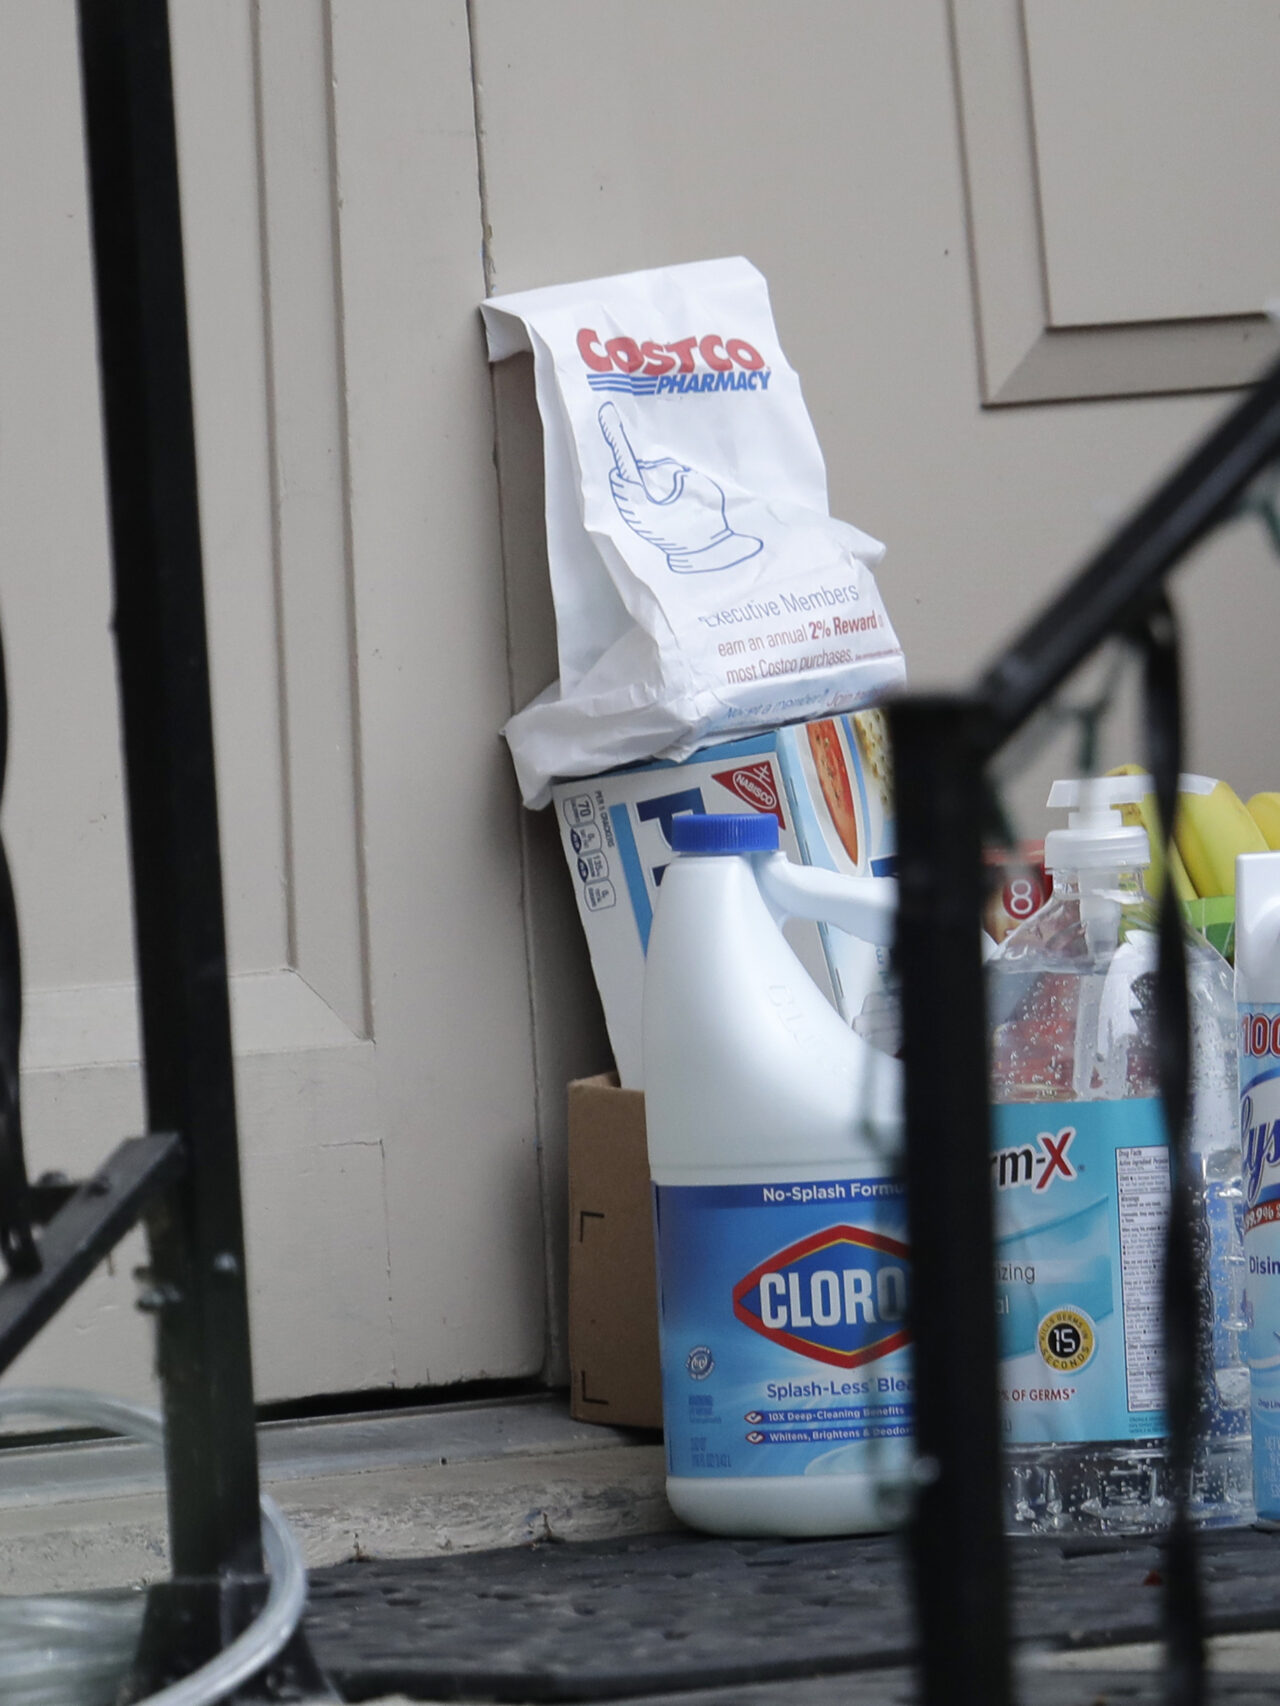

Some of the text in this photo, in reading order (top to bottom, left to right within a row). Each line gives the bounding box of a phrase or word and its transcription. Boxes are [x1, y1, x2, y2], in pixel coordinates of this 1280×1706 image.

[576, 328, 767, 377] COSTCO
[656, 370, 771, 395] PHARMACY
[779, 584, 860, 615] Members
[718, 610, 878, 658] earn an annual 2% Reward
[726, 665, 758, 685] most
[759, 656, 798, 679] Costco
[735, 772, 776, 807] NABISCO
[577, 800, 592, 818] 70
[763, 1182, 847, 1203] No-Splash
[759, 1266, 907, 1329] CLORO
[1053, 1328, 1076, 1353] 15
[1011, 1389, 1026, 1401] OF
[768, 1411, 785, 1423] 10X
[769, 1431, 812, 1444] Whitens,
[811, 1428, 861, 1442] Brightens
